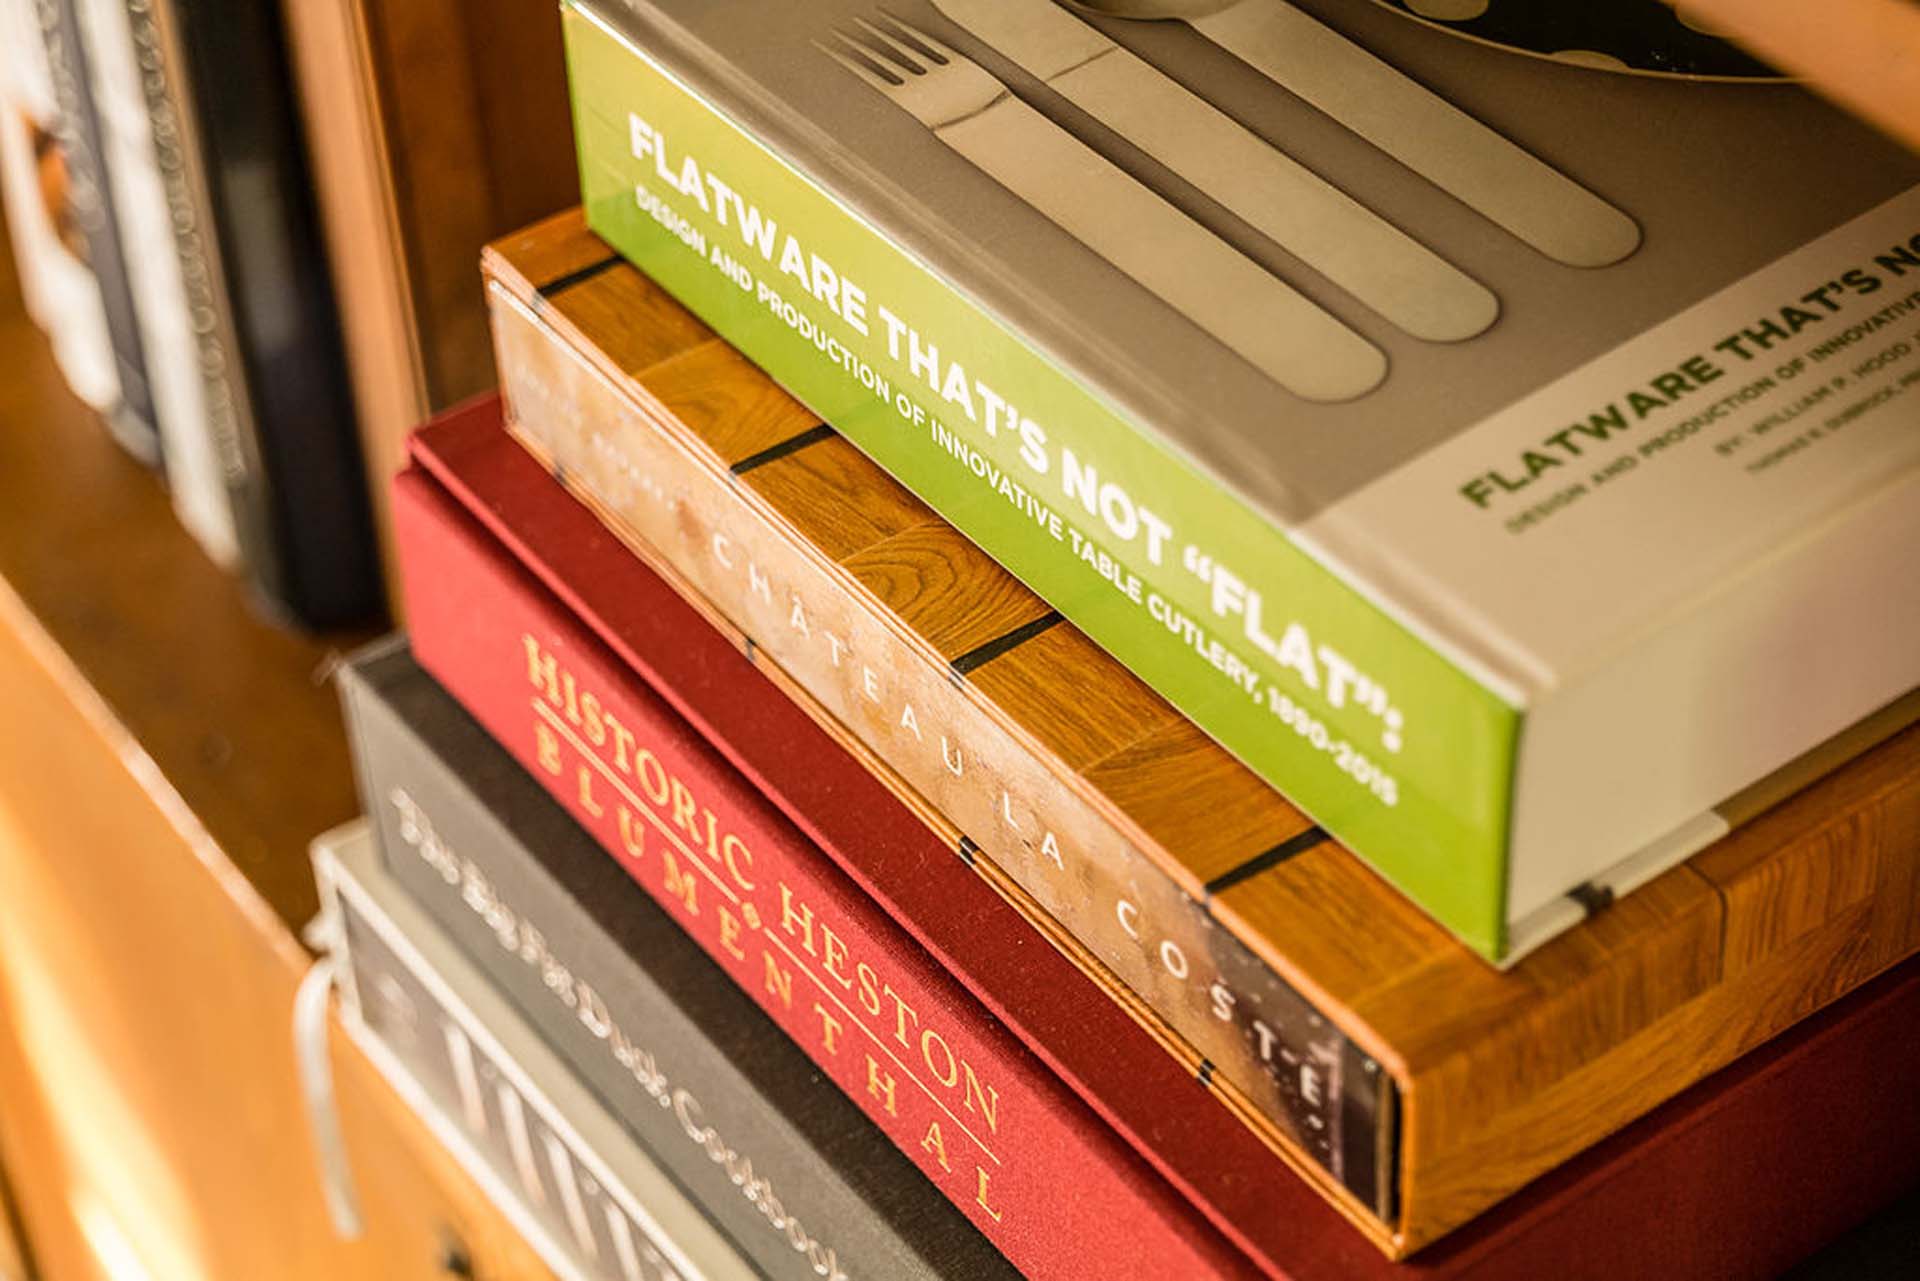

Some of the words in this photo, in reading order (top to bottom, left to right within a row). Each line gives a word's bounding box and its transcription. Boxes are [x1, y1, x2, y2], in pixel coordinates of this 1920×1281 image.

[628, 112, 870, 338] FLATWARE
[877, 304, 1050, 475] THAT'S
[1061, 447, 1173, 568] NOT
[635, 186, 707, 262] DESIGN
[710, 245, 754, 294] AND
[757, 280, 892, 404] PRODUCTION
[894, 393, 927, 430] OF
[931, 418, 1064, 543] INNOVATIVE
[1068, 531, 1143, 605] TABLE
[1147, 594, 1263, 705] CUTLERY,
[1458, 354, 1727, 510] FLATWARE
[1713, 267, 1884, 362] THAT'S
[1591, 453, 1640, 487] AND
[1636, 374, 1777, 460] PRODUCTION
[1774, 356, 1806, 380] OF
[713, 532, 964, 778] CHÂTEAU
[524, 633, 757, 891] HISTORIC
[779, 879, 1000, 1135] HESTON
[535, 722, 1002, 1222] BLUMENTHAL
